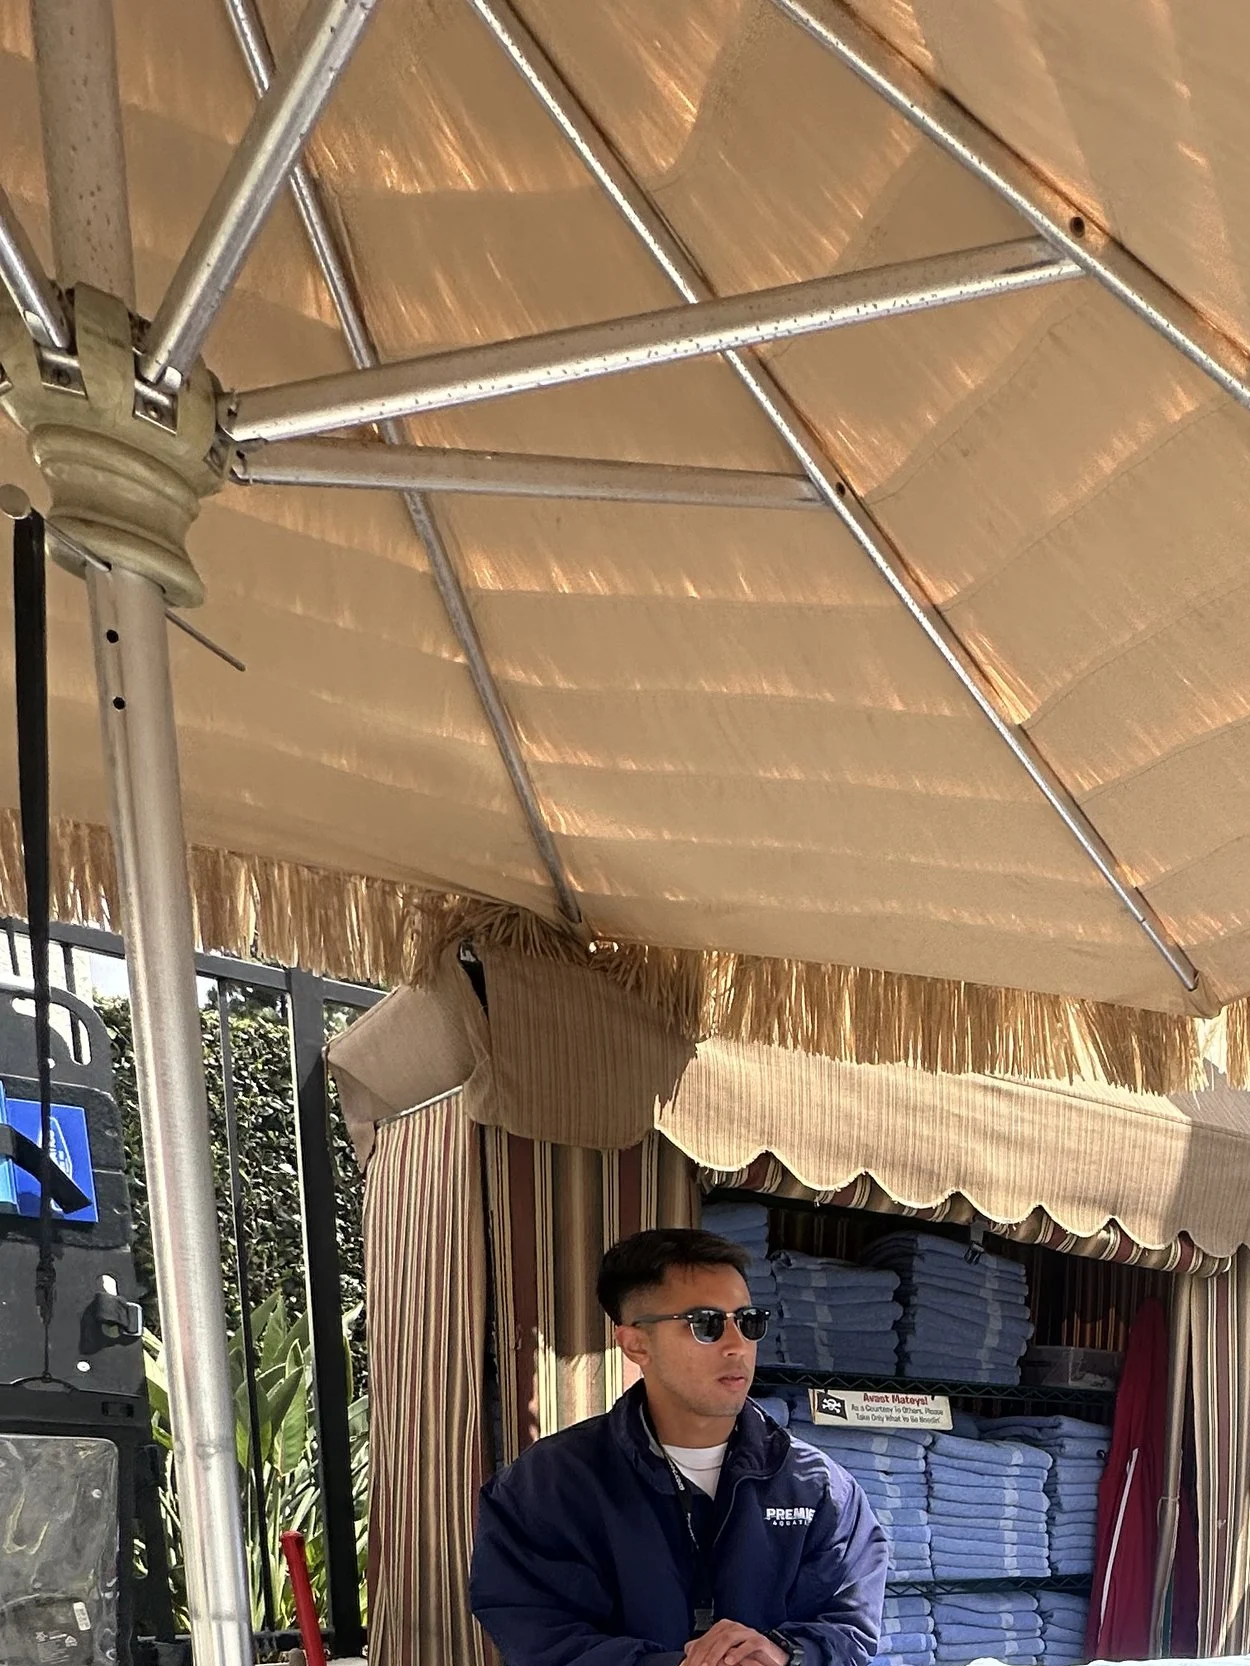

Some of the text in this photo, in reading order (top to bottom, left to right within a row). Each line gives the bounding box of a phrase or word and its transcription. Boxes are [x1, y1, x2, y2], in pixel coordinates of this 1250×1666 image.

[863, 1392, 928, 1407] Avast Mateys!
[865, 1404, 893, 1413] Courtesy
[855, 1413, 870, 1421] Take
[871, 1413, 885, 1423] Only
[885, 1414, 902, 1422] What
[766, 1507, 816, 1522] PREMIE
[772, 1519, 810, 1527] AQUATI
